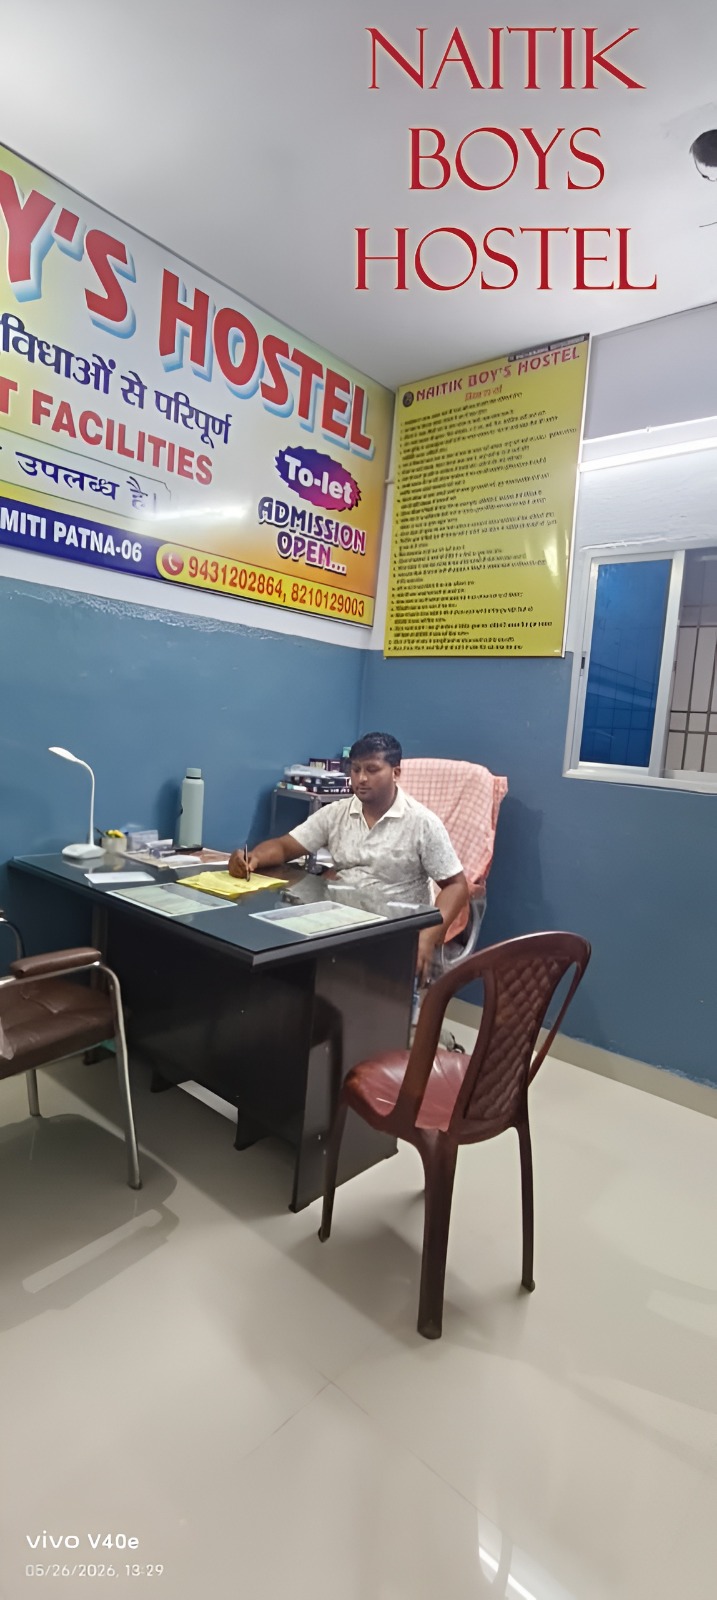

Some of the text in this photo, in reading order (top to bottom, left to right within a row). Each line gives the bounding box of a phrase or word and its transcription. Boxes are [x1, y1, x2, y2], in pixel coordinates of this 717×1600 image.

[159, 268, 372, 452] HOSTEL
[416, 377, 463, 402] NAITIK
[468, 364, 512, 388] BOY'S
[518, 346, 580, 376] HOSTEL
[32, 389, 213, 485] FACILITIES
[120, 371, 147, 409] से
[154, 390, 232, 448] परिपूर्ण
[15, 451, 120, 500] उपलब्ध
[284, 454, 353, 505] To-let
[53, 520, 142, 561] PATNA-06
[258, 496, 366, 553] ADMISSION
[277, 531, 347, 575] OPEN...
[188, 556, 365, 617] 9431202864, 8210129003
